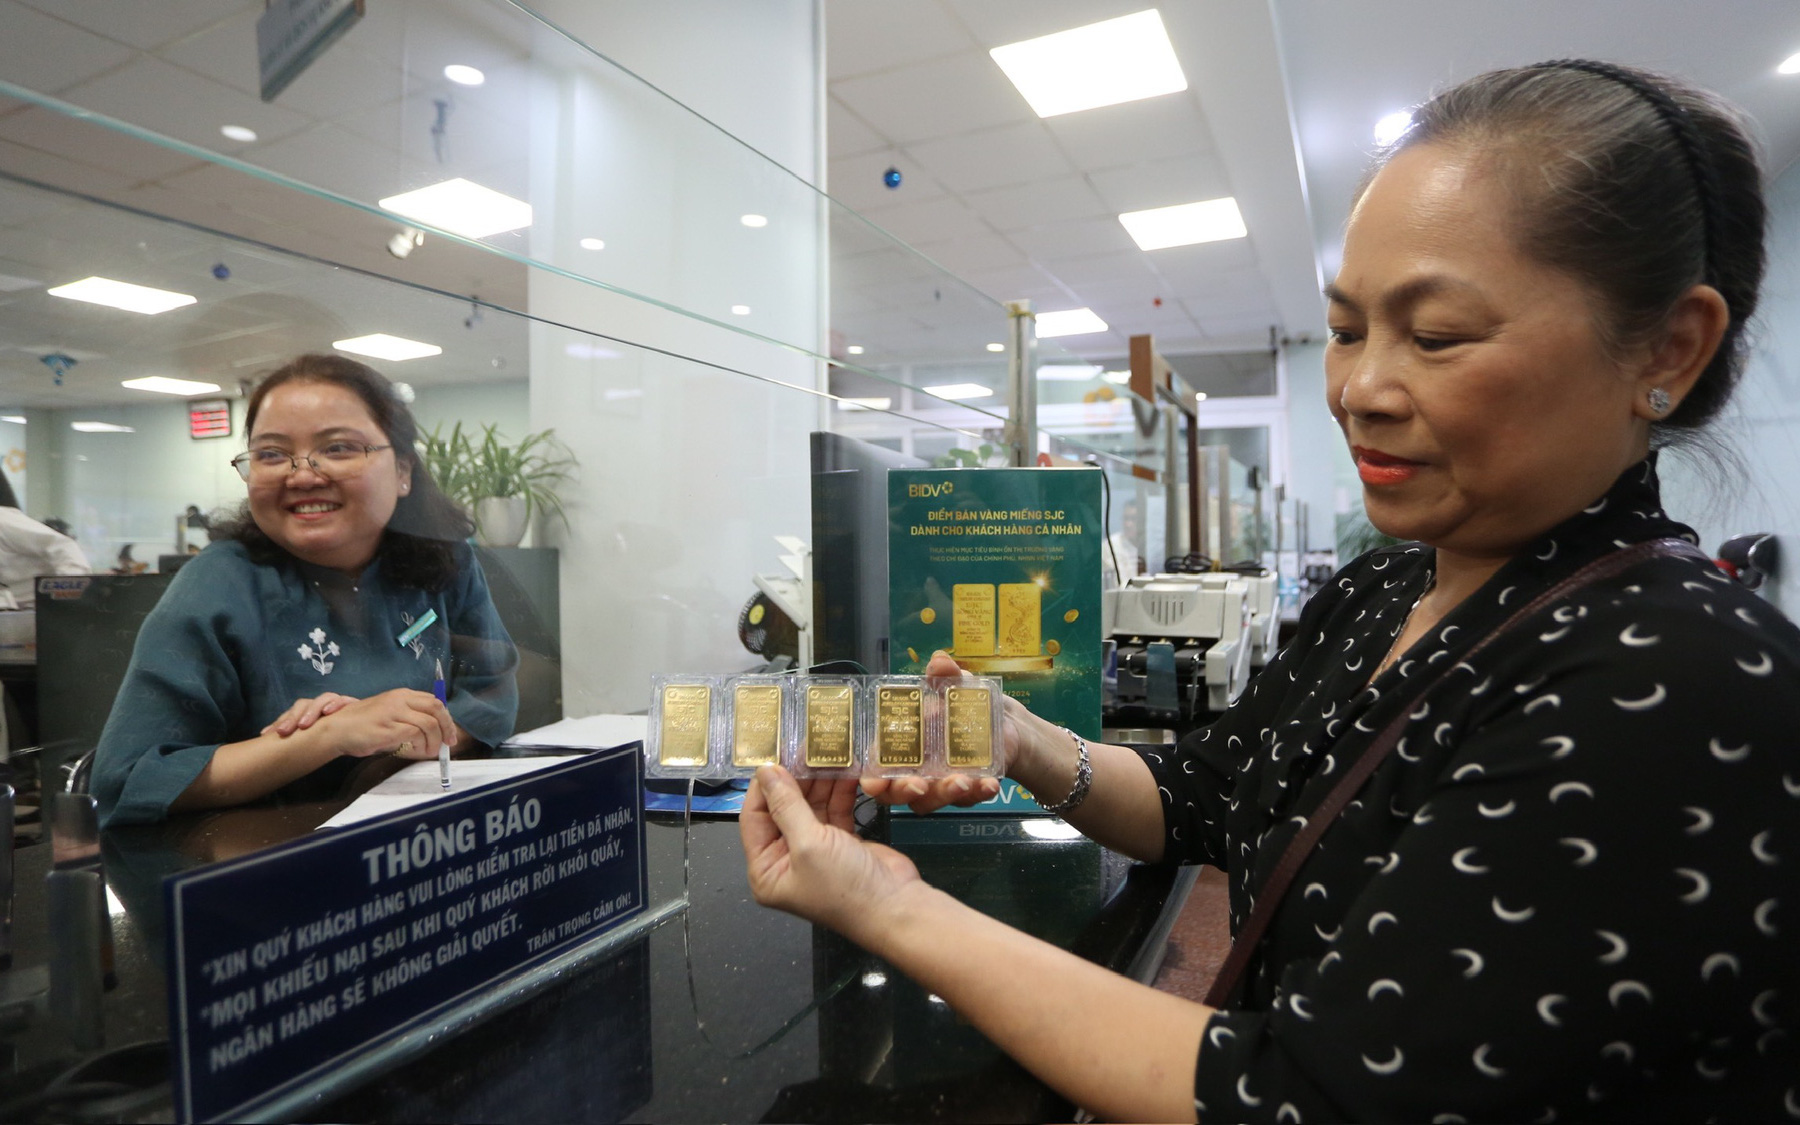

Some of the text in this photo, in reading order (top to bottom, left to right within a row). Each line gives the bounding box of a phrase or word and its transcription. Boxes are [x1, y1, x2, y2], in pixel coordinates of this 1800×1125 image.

[909, 484, 941, 498] BIDV
[910, 522, 1082, 536] DÀNH CHO KHÁCH HÀNG CÁ NHÂN
[928, 507, 1065, 521] ĐIỂM BÁN VÀNG MIẾNG SJC
[820, 706, 838, 715] SJC
[891, 706, 909, 715] SJC
[362, 794, 541, 884] THÔNG BÁO
[252, 926, 291, 969] QUÝ
[296, 911, 357, 951] KHÁCH
[361, 894, 405, 926] HÀNG
[408, 879, 433, 908] VUI
[437, 867, 474, 897] LÒNG
[477, 845, 510, 880] KIỂM
[512, 842, 536, 867] TRA
[539, 833, 557, 857] LẠI
[560, 819, 585, 848] TIỀN
[587, 814, 601, 838] ĐÃ
[604, 806, 634, 832] NHẬN.
[263, 952, 328, 1006] KHIẾU
[334, 941, 367, 974] NẠI
[371, 925, 407, 959] SAU
[411, 911, 441, 943] KHI
[445, 893, 477, 929] QUÝ
[481, 878, 529, 913] KHÁCH
[532, 863, 555, 892] RỜI
[558, 848, 588, 880] KHỎI
[590, 834, 624, 867] QUẦY,
[558, 911, 592, 938] TRỌNG
[593, 899, 614, 921] CẢM
[615, 892, 632, 910] ƠN!
[210, 908, 523, 1073] NGÂN HÀNG SẼ KHÔNG GIẢI QUYẾT.
